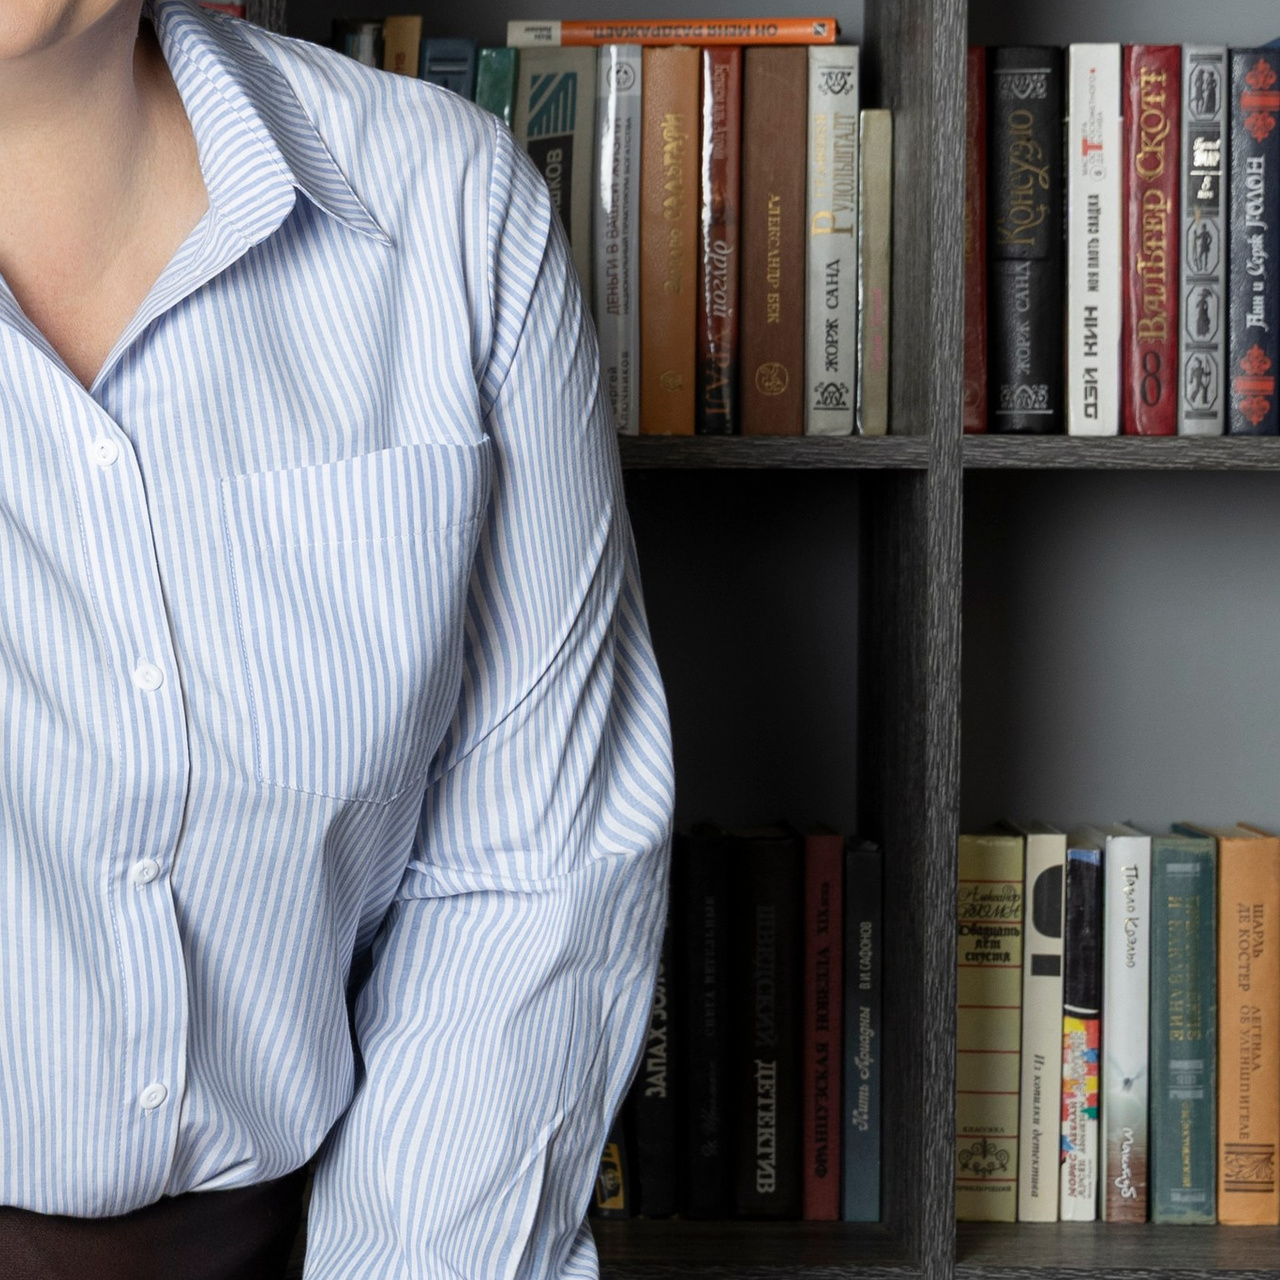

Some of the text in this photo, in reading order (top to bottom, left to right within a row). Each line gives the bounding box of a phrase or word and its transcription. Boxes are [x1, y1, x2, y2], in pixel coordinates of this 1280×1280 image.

[704, 24, 778, 39] ОН МЕНЯ
[621, 116, 632, 315] НАЦИОНАЛЬНЫЙ ПРАКТИКУМ БОГАТСТВА
[1136, 67, 1171, 343] ВАЛЬТЕР СКОТТ
[1245, 234, 1265, 276] Серж
[605, 243, 620, 316] ДЕНЬГИ В
[708, 239, 736, 318] другой
[766, 193, 782, 324] АЛЕКСАНДР БЕК
[1083, 194, 1100, 420] ДЭЙ КИН МОЯ ПЛОТЬ СЛАДКА
[824, 259, 840, 372] ЖОРЖ САНД
[1015, 260, 1032, 375] ЖОРЖ САНД
[618, 350, 631, 431] Ключников
[1140, 351, 1162, 408] 8
[1122, 863, 1139, 969] Пауло Коэльо
[1237, 902, 1251, 992] ДЕ КОСТЕР
[1252, 903, 1264, 958] ШАРЛЬ
[645, 1027, 667, 1097] ЗАПАХ
[816, 909, 831, 1179] ФРАНЦУЗСКАЯ НОВЕЛЛА XIX
[853, 1006, 876, 1131] Нить Ариадны
[1237, 1005, 1251, 1140] ОБ УЛЕНШПИГЕЛЕ
[1251, 1005, 1262, 1072] ЛЕГЕНДА
[754, 1059, 777, 1193] ДЕТЕКТИВ
[1030, 1054, 1045, 1198] Из копилки детектива
[1114, 1127, 1137, 1199] Мактуб
